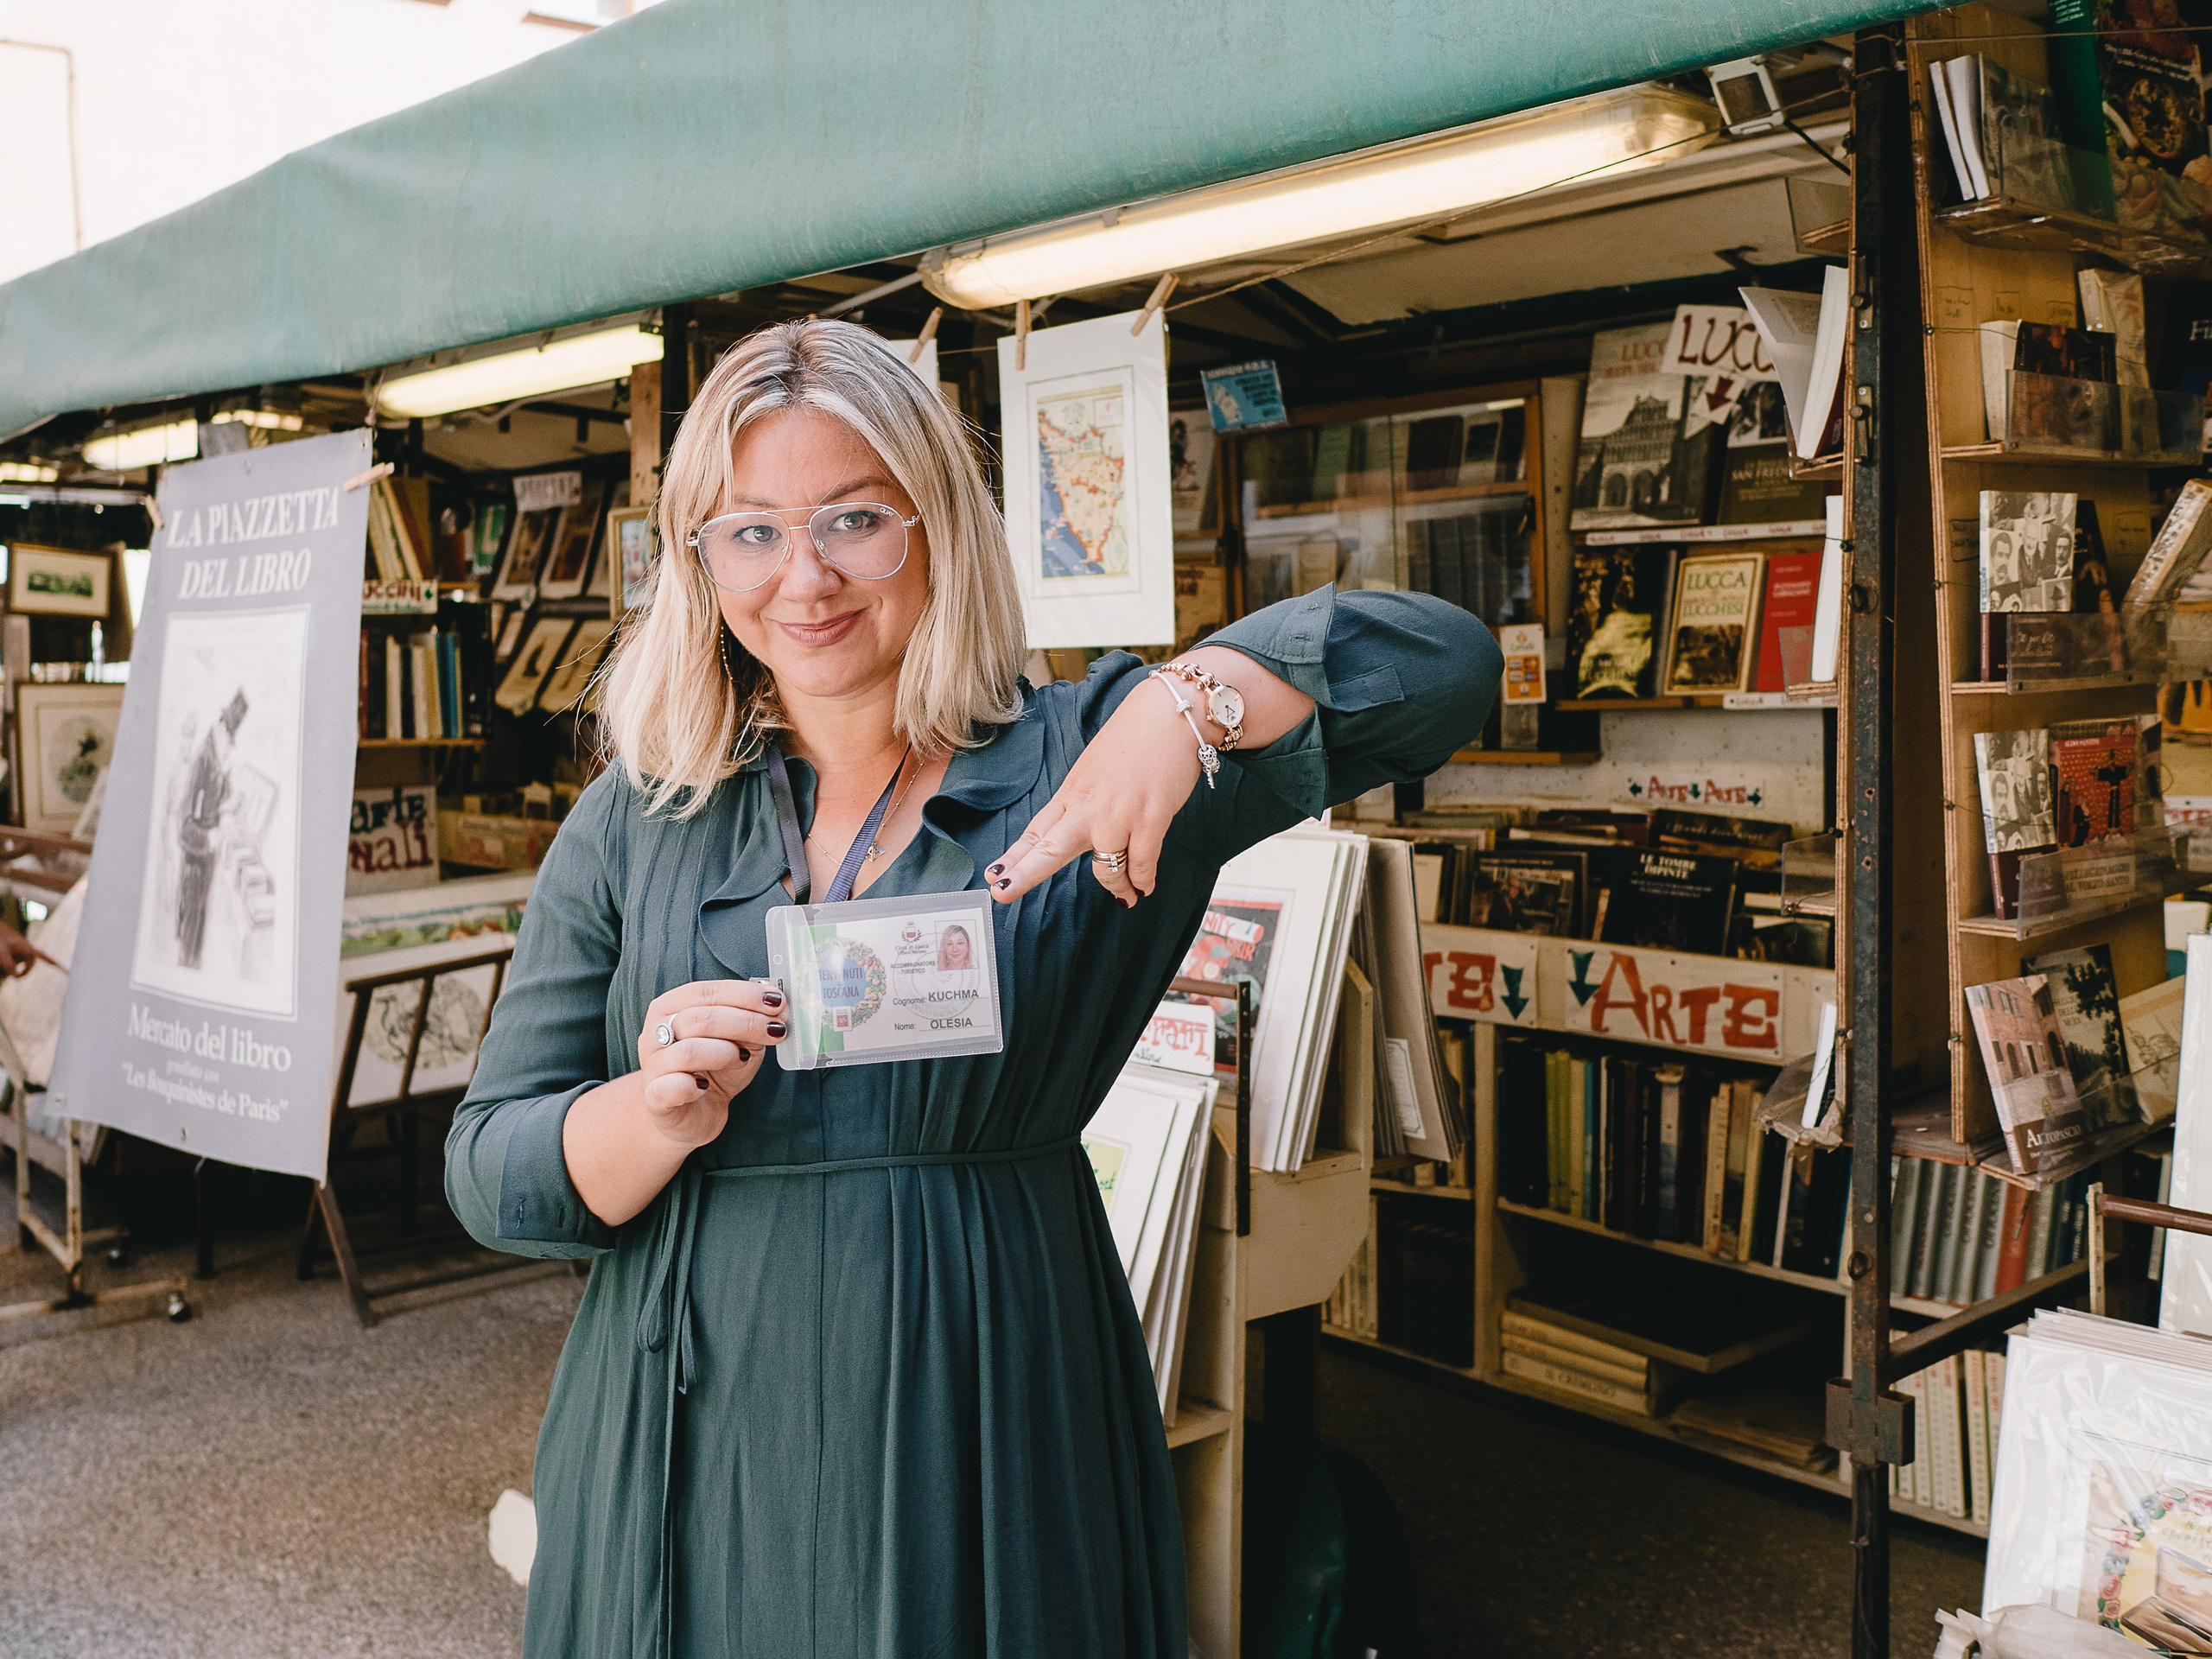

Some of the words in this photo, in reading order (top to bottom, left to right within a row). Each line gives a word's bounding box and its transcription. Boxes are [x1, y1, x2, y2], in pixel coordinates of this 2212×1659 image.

[1678, 315, 1775, 372] LUCC
[166, 510, 202, 548] LA
[207, 485, 339, 545] PIAZZETTA
[179, 557, 232, 600] DEL
[233, 547, 312, 596] LIBRO
[1687, 570, 1746, 590] LUCCA
[1202, 913, 1235, 936] NITY
[822, 986, 860, 999] TOSCANA
[928, 989, 979, 1001] KUCHMA
[1591, 951, 1779, 1049] ARTE
[930, 1018, 973, 1029] OLESIA
[127, 1002, 192, 1054] Mercato
[194, 1020, 227, 1061] del
[232, 1027, 292, 1072] libro
[218, 1089, 236, 1115] de
